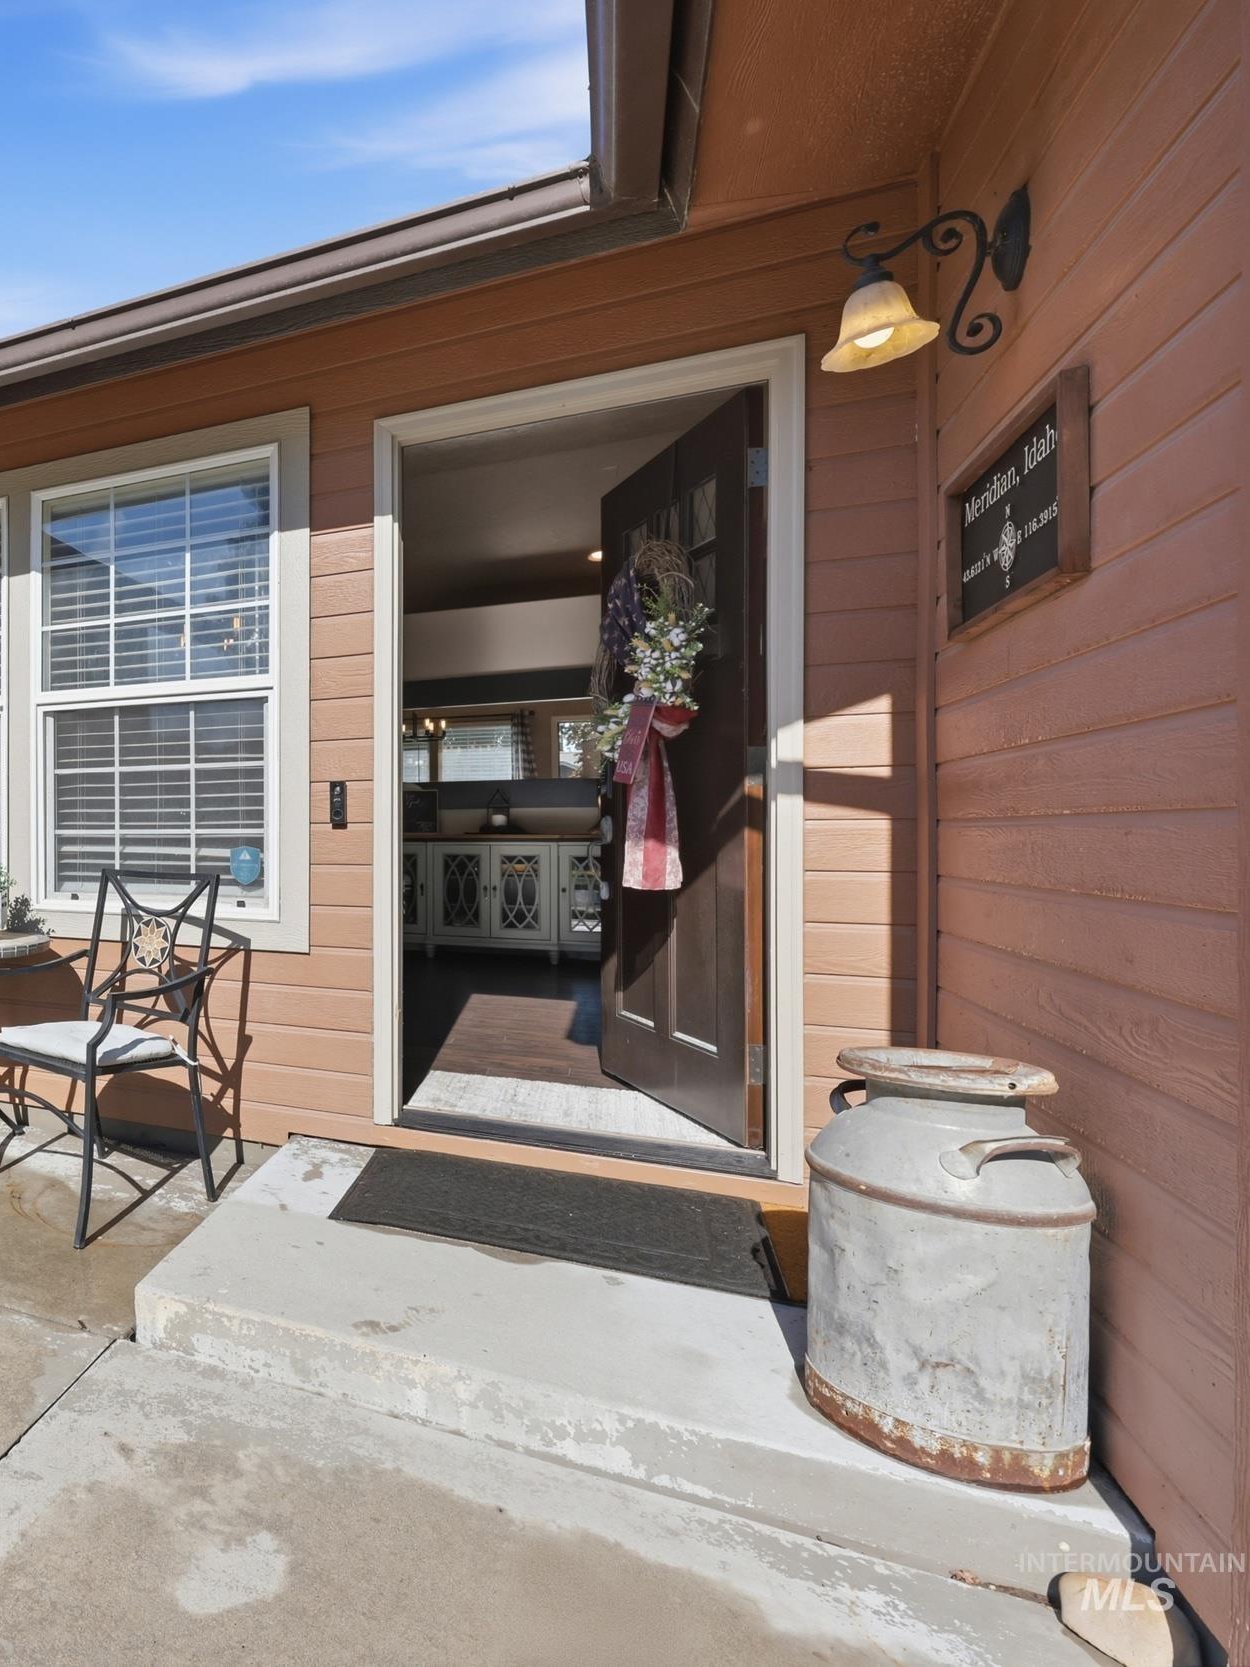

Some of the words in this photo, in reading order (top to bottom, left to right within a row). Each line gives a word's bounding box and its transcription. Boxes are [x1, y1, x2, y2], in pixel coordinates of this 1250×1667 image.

[964, 466, 1020, 528] Meridian,
[1005, 503, 1011, 519] N
[1005, 575, 1011, 589] S
[616, 759, 632, 775] USA
